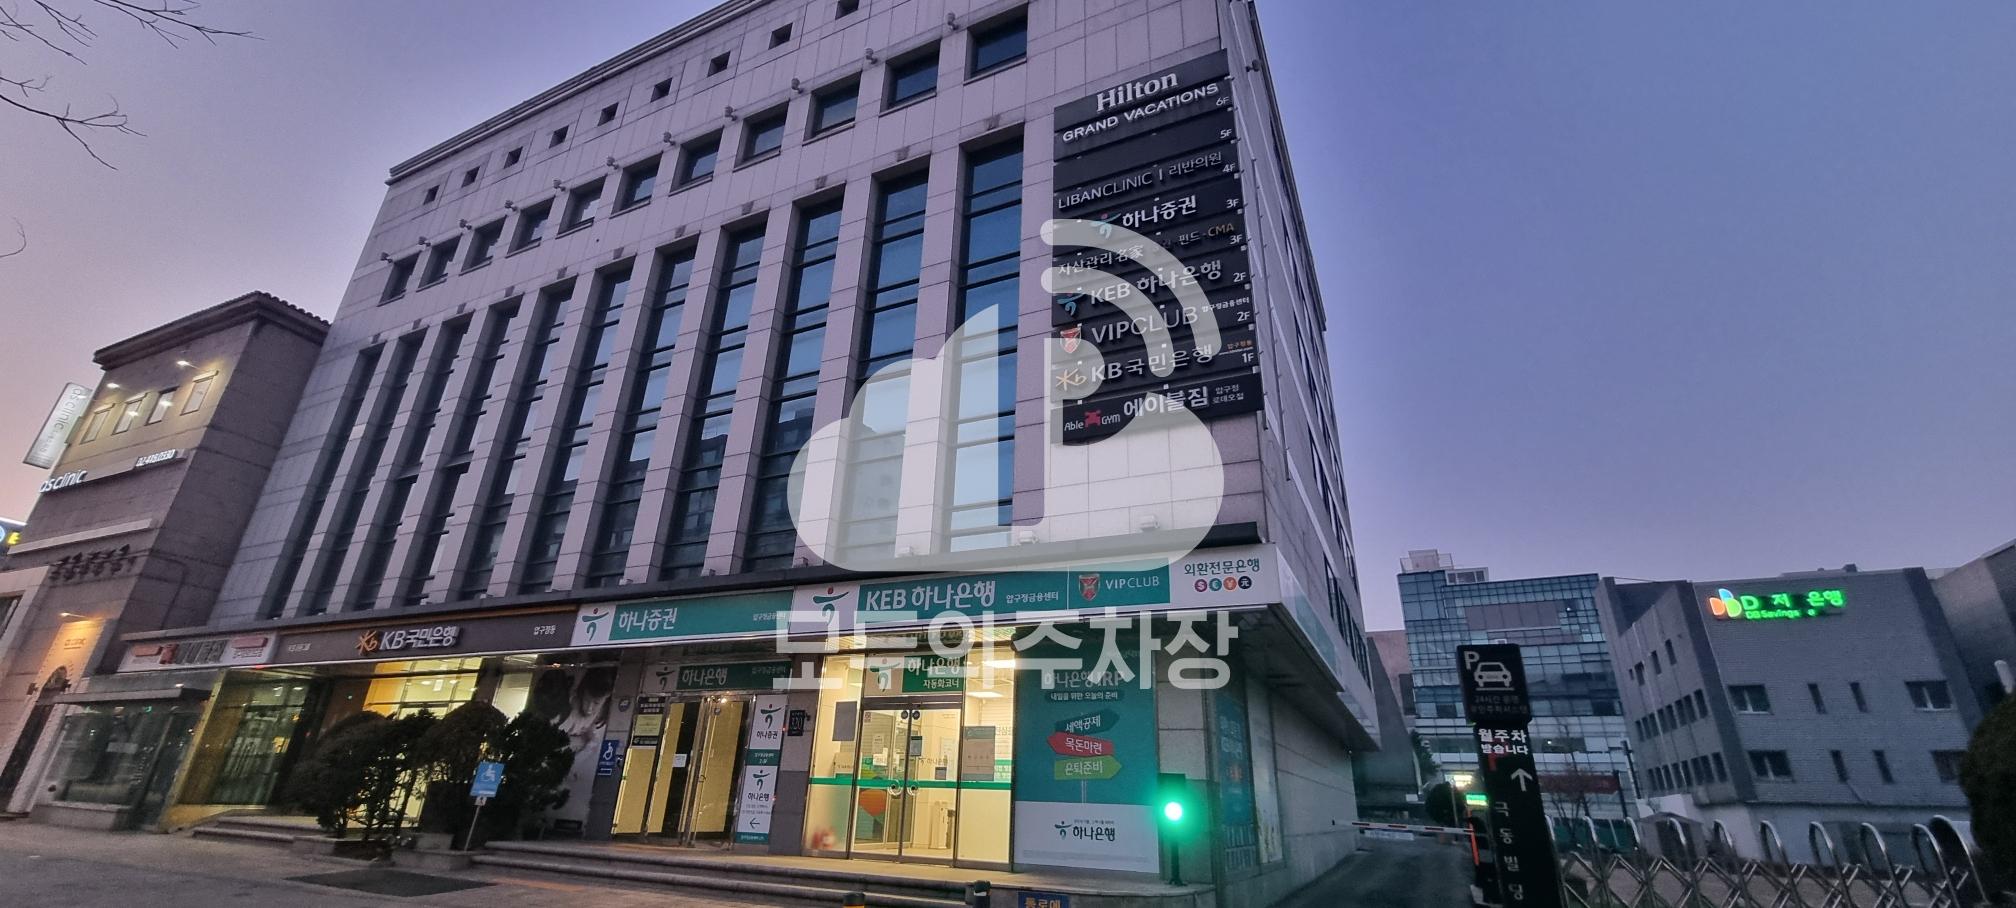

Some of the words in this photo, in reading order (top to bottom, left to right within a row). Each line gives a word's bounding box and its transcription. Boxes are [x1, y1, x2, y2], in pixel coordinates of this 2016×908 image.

[1097, 73, 1178, 112] Hilton
[1216, 96, 1229, 106] 6F
[1062, 116, 1119, 142] GRAND
[1124, 83, 1219, 121] VACATIONS
[1220, 129, 1232, 139] 5F
[1222, 164, 1236, 173] 4F
[1058, 172, 1153, 209] LIBANCLINIC
[1169, 152, 1222, 175] 리반의원
[1122, 195, 1197, 228] 하나증권
[1226, 199, 1240, 208] 3F
[1208, 223, 1234, 237] CMA
[1230, 235, 1243, 245] 3F
[1090, 283, 1131, 305] KEB
[1137, 259, 1221, 294] 하나은행
[1233, 273, 1247, 283] 2F
[1237, 311, 1250, 321] 2F
[1242, 353, 1254, 363] 1F
[1123, 386, 1209, 417] 에이블짐
[1064, 417, 1084, 431] Able
[1184, 558, 1261, 576] 외환전문은행
[866, 589, 907, 611] KEB
[912, 580, 996, 610] 하나은행
[1006, 591, 1059, 604] 압구정금융센터
[619, 607, 678, 632] 하나증권
[380, 626, 458, 649] KB국민은행
[907, 656, 961, 676] 하나은행
[1464, 651, 1480, 670] P
[682, 667, 728, 685] 하나은행
[923, 678, 960, 688] 자동화코너
[1066, 715, 1101, 733] 세액공제
[1478, 728, 1526, 744] 월주차
[1065, 737, 1102, 755] 목돈마련
[1481, 744, 1529, 755] 받습니다
[1065, 761, 1104, 775] 은퇴준비
[1072, 826, 1116, 842] 하나은행
